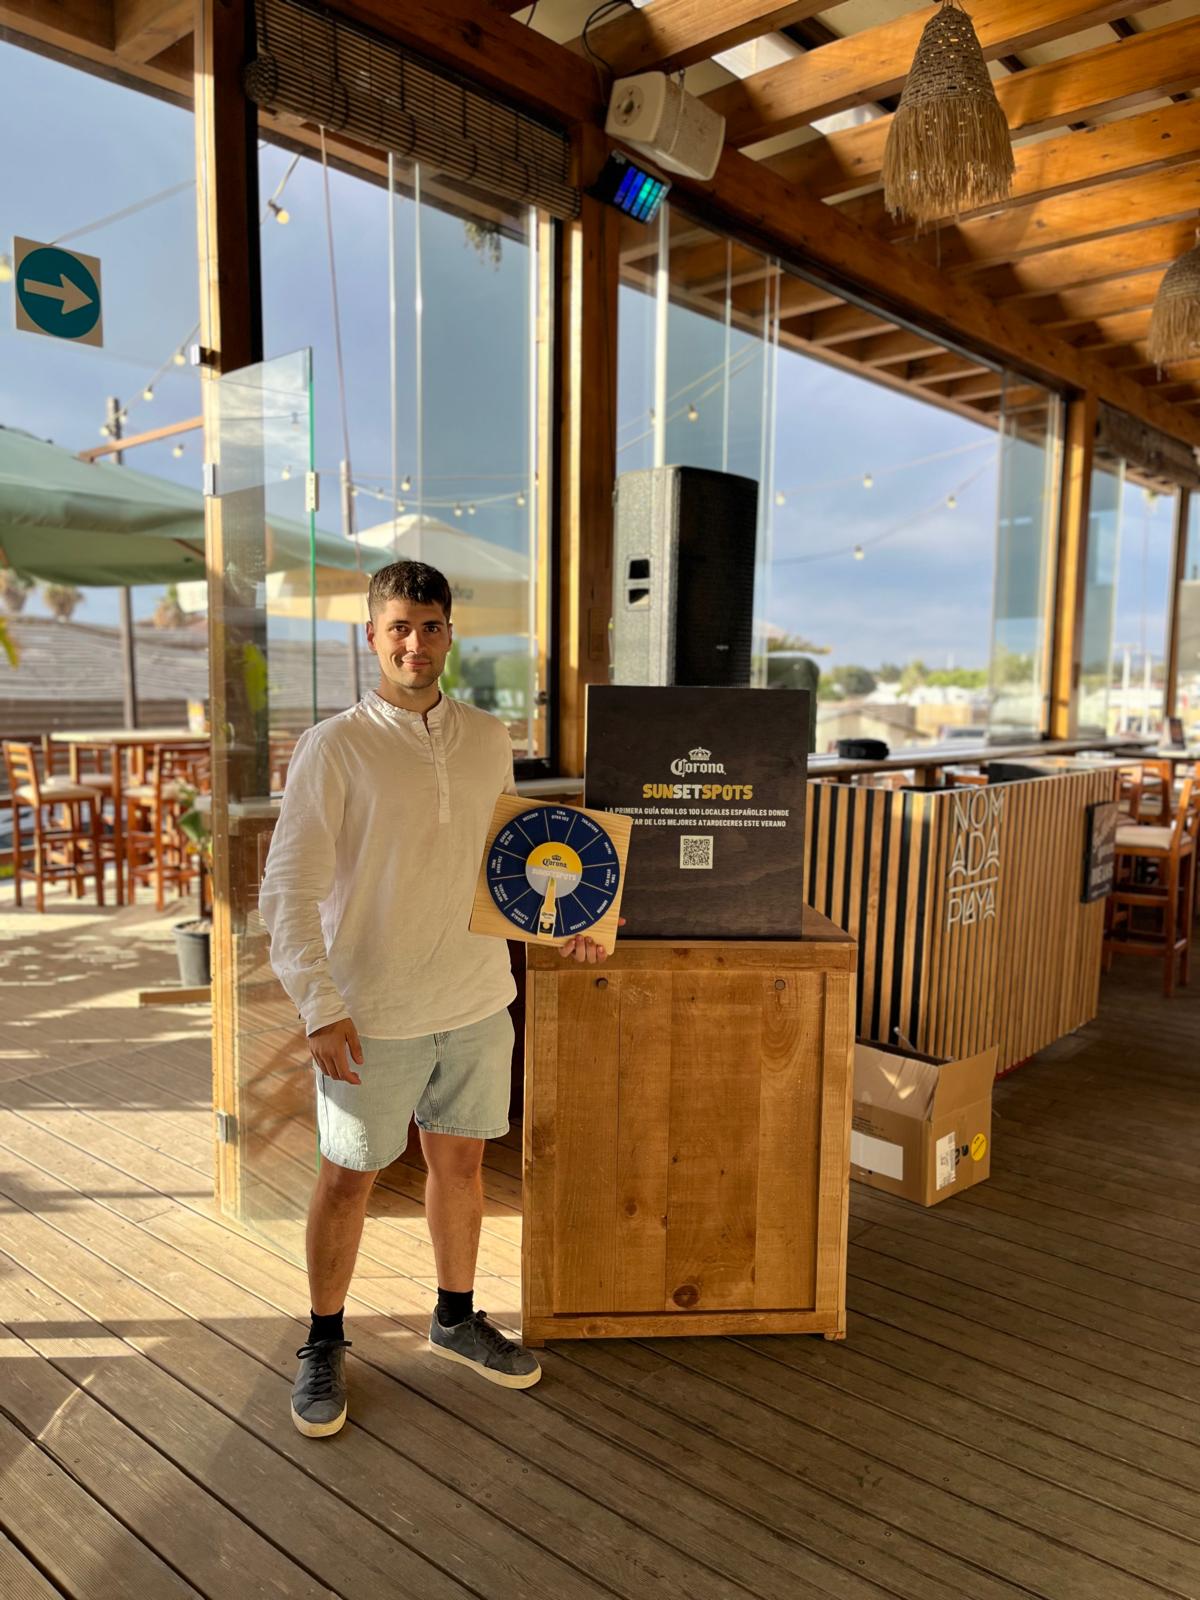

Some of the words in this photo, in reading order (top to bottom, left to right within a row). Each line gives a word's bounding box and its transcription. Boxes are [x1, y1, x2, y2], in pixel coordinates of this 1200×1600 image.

[670, 758, 726, 778] Corona
[642, 783, 753, 800] SUNSETSPOTS
[614, 807, 643, 815] PRIMERA
[644, 806, 660, 815] GUÍA
[660, 807, 674, 815] CON
[674, 808, 688, 816] LOS
[688, 808, 700, 816] 100
[701, 808, 730, 816] LOCALES
[730, 807, 767, 816] ESPAÑOLES
[768, 809, 789, 817] DONDE
[644, 818, 653, 826] DE
[653, 818, 667, 826] LOS
[667, 818, 697, 826] MEJORES
[698, 819, 743, 827] ATARDECERES
[743, 820, 760, 828] ESTE
[760, 820, 787, 828] VERANO
